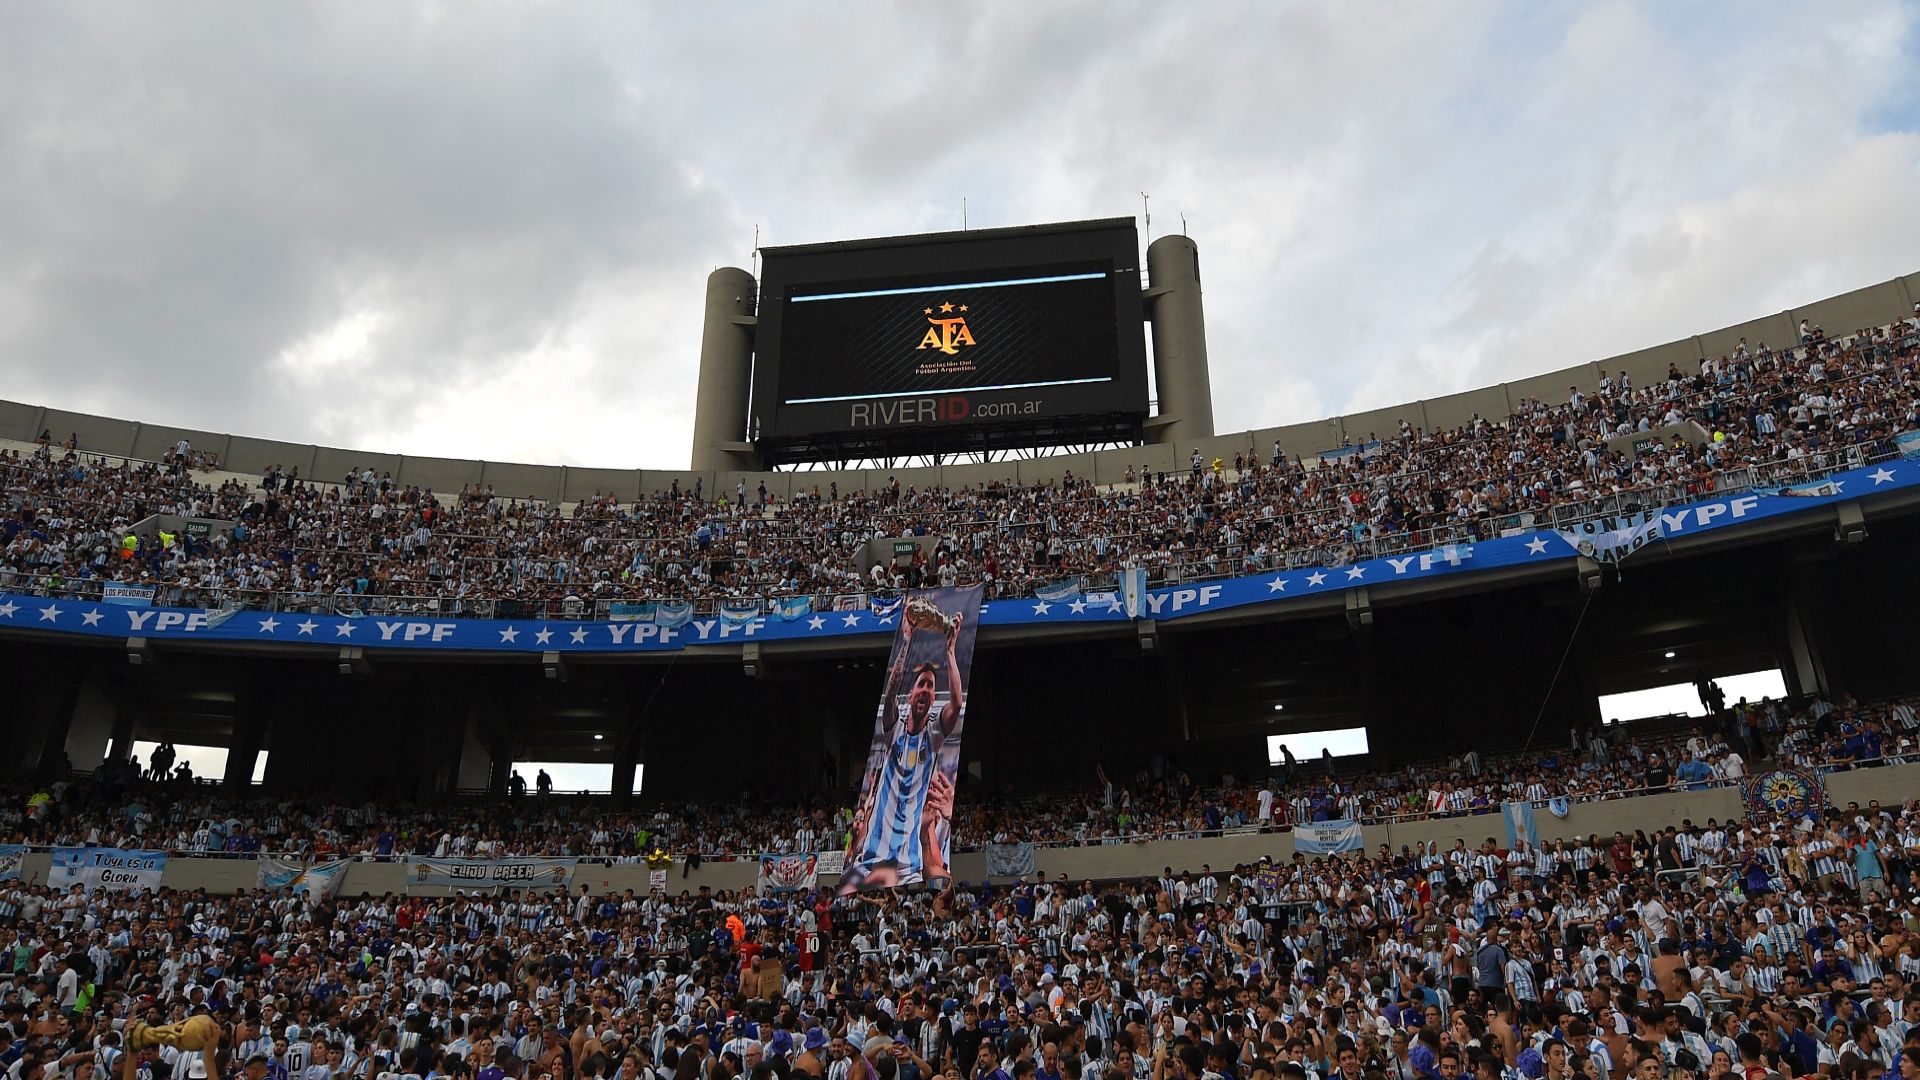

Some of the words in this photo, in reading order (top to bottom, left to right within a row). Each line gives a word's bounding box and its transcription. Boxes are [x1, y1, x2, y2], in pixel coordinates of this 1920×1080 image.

[915, 316, 977, 355] AFA
[919, 361, 958, 369] Asociación
[940, 365, 977, 374] Argentino
[1661, 495, 1758, 532] YPF
[187, 524, 208, 533] SALIDA
[895, 544, 913, 552] SALIDA
[105, 588, 116, 597] LOS
[117, 588, 154, 599] POLVORINES
[1146, 584, 1222, 614] YPF
[127, 610, 209, 631] YPF
[376, 621, 457, 642] YPF
[493, 864, 535, 881] CREER
[1423, 924, 1438, 933] STAY
[805, 936, 820, 954] 10
[288, 1053, 302, 1073] 10
